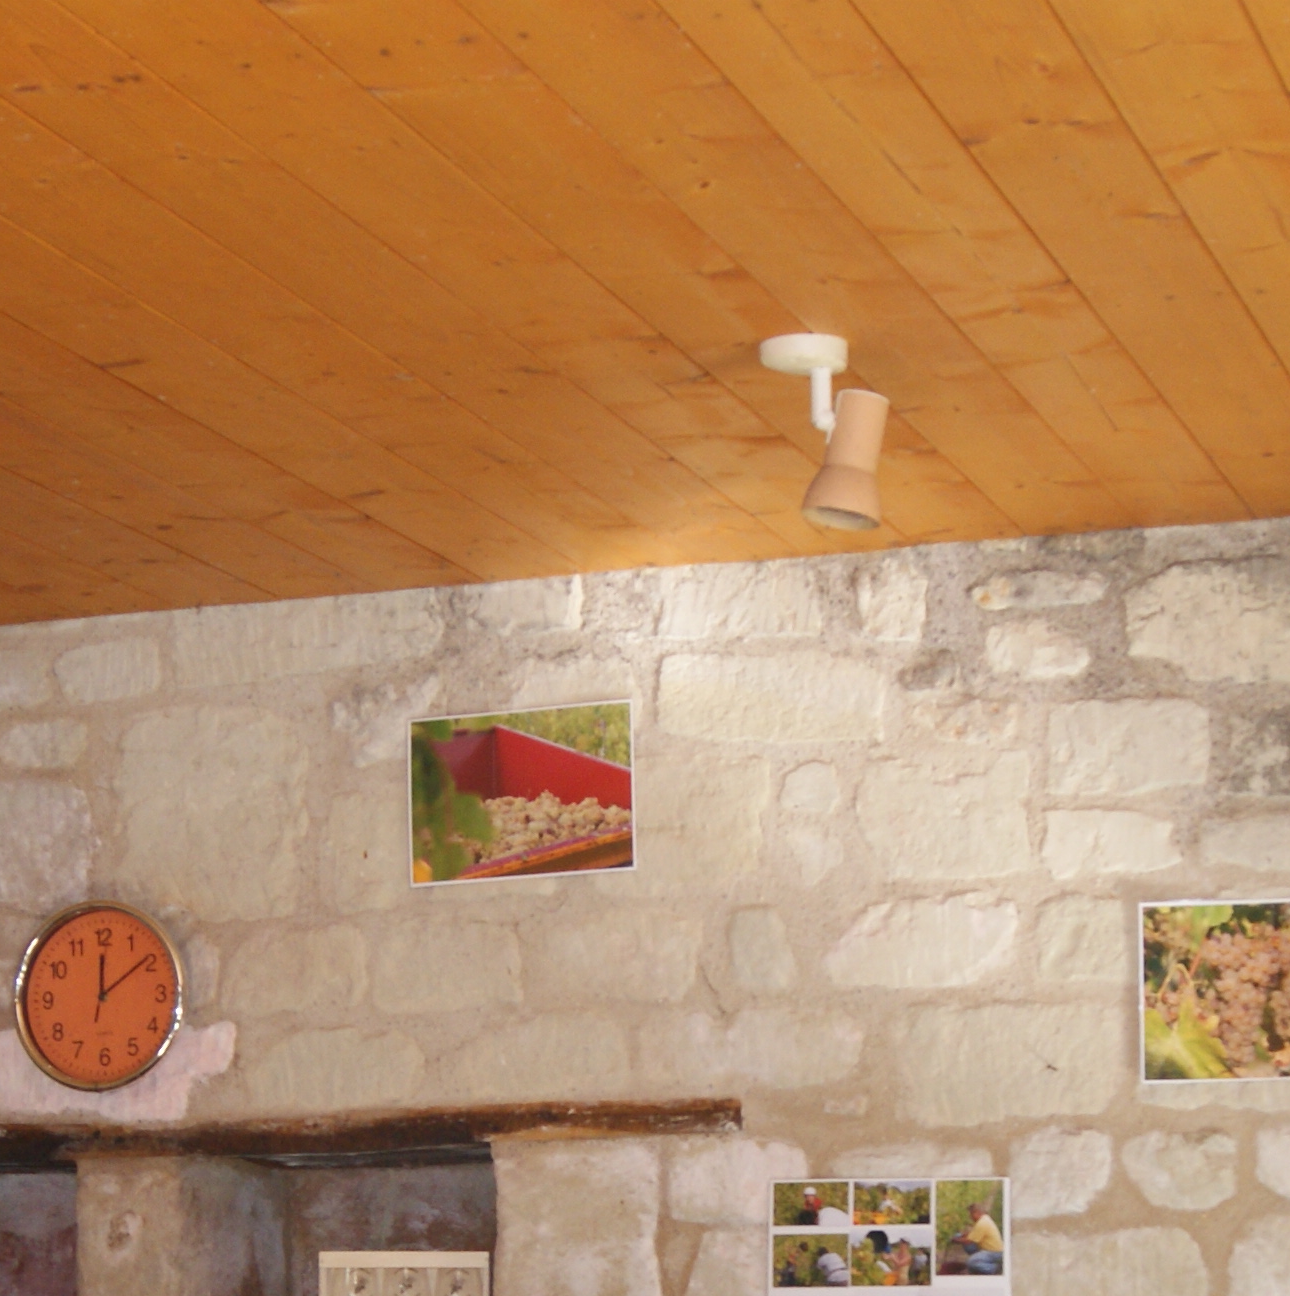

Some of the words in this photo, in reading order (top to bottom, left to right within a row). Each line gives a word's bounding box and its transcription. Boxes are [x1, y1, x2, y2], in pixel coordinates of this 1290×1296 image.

[95, 928, 112, 947] 12
[127, 935, 134, 951] 1
[69, 939, 84, 956] 11
[50, 961, 67, 980] 10
[145, 953, 156, 972] 2
[42, 991, 54, 1010] 9
[155, 984, 167, 1003] 3
[52, 1023, 64, 1041] 8
[147, 1017, 158, 1033] 4
[72, 1041, 83, 1058] 7
[127, 1038, 139, 1056] 5
[99, 1048, 111, 1066] 6
